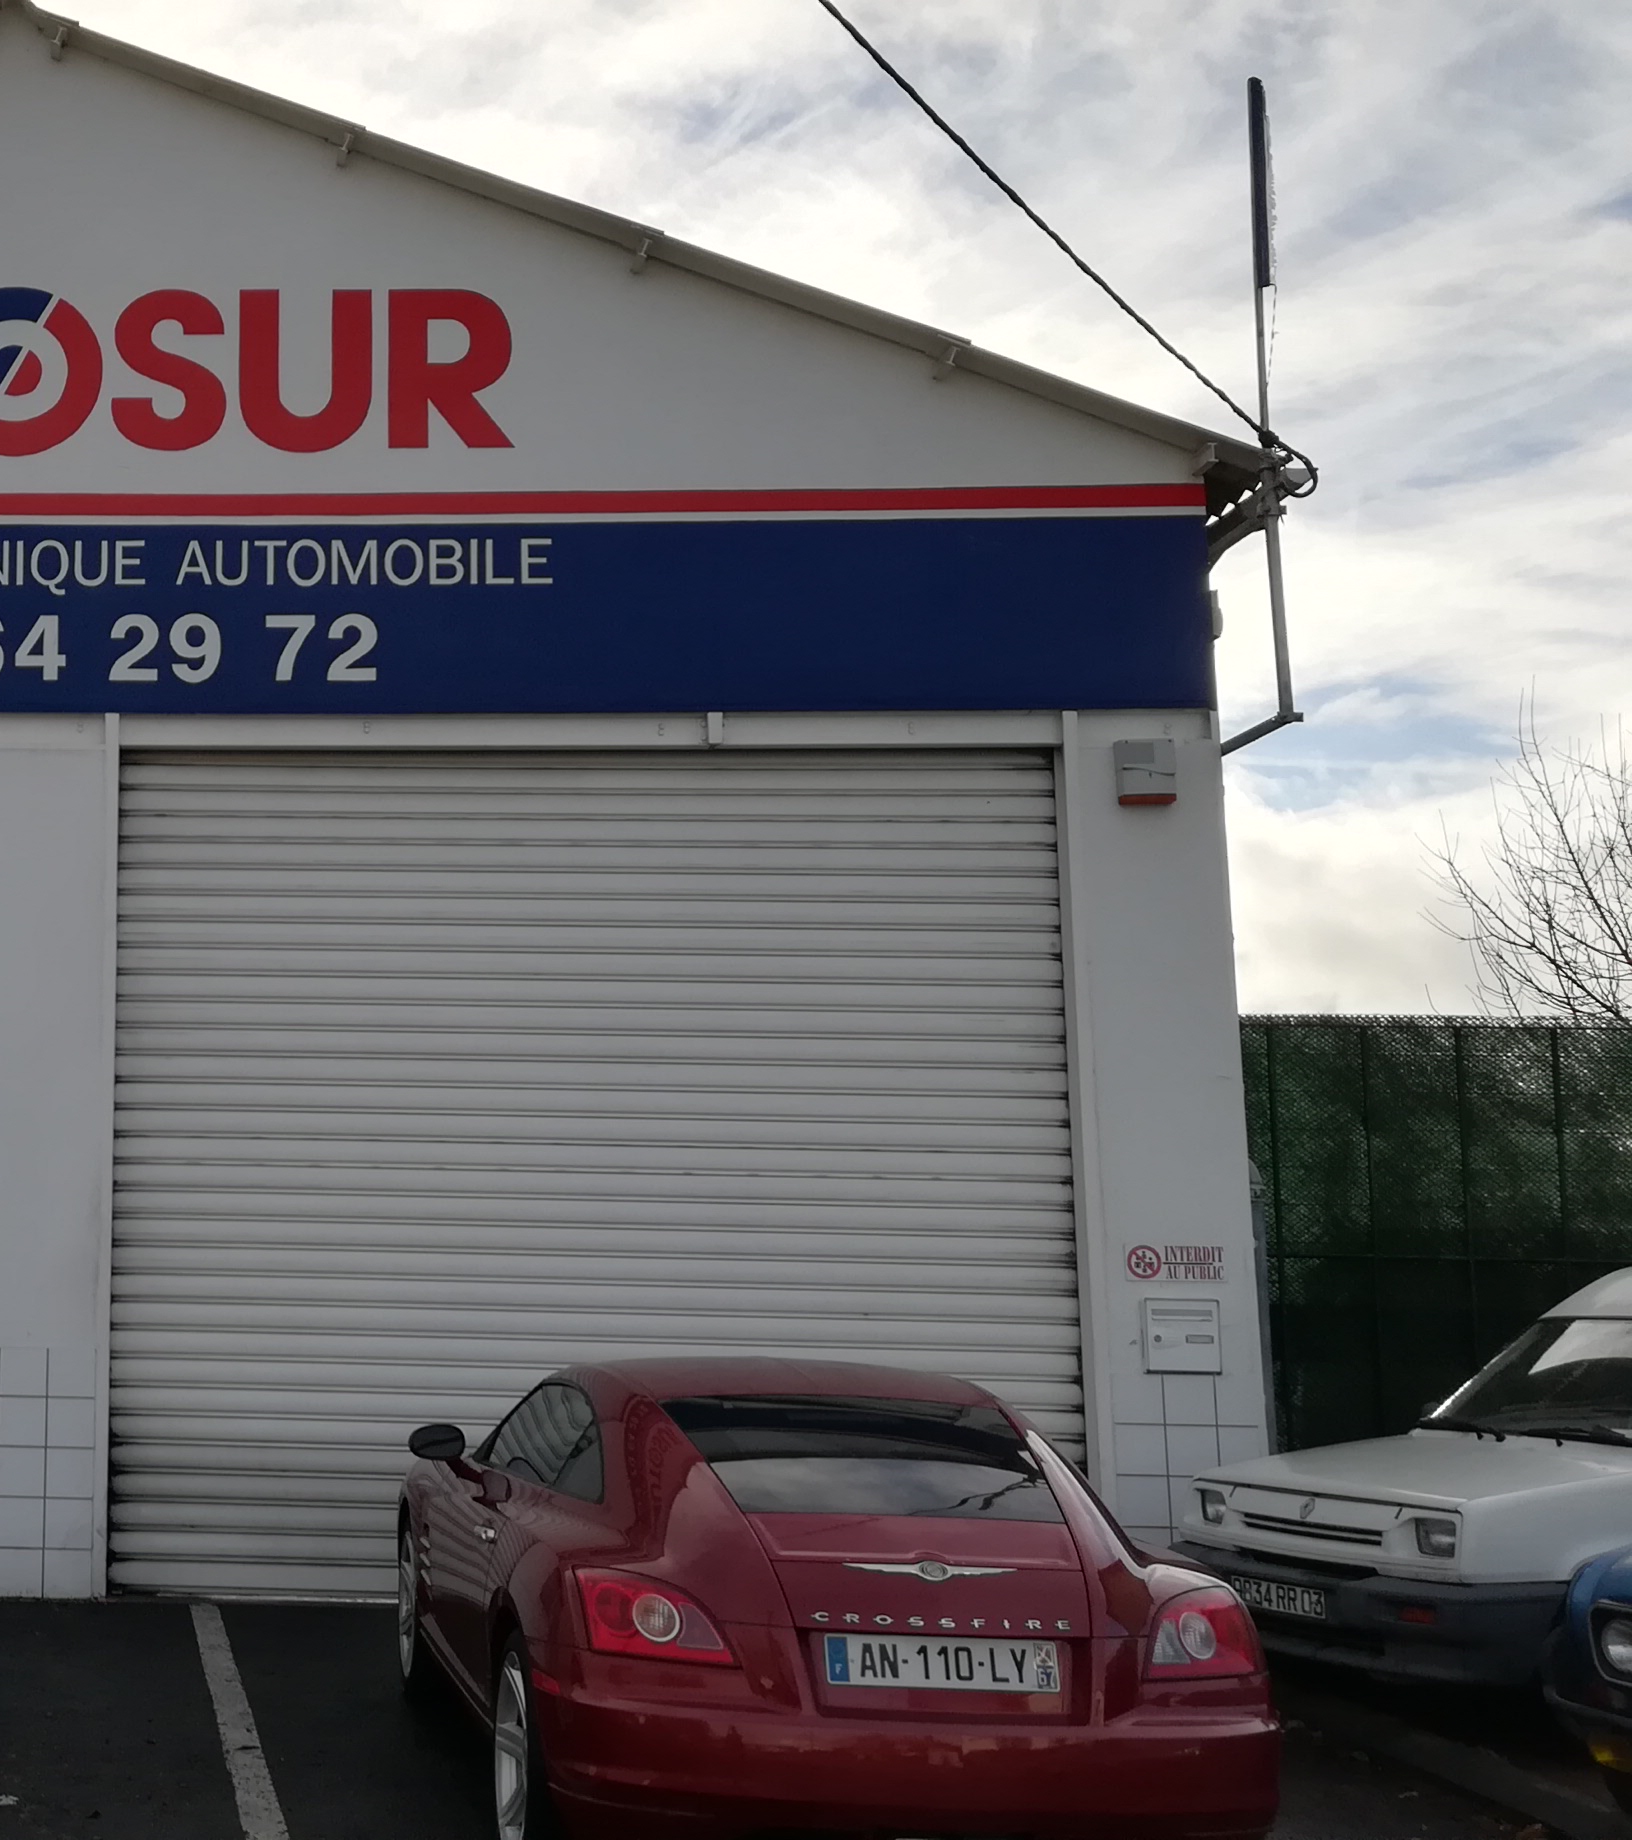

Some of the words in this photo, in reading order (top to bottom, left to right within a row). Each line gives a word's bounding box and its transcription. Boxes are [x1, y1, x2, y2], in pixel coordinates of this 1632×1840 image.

[175, 538, 554, 587] AUTOMOBILE
[108, 613, 222, 684] 29
[265, 613, 378, 682] 72
[1163, 1245, 1225, 1263] INTERDIT
[1165, 1265, 1181, 1280] AU
[1183, 1265, 1225, 1281] PUBLIC
[1276, 1585, 1298, 1612] RR
[1301, 1588, 1324, 1617] 03
[810, 1610, 1072, 1631] CROSSFIRE
[835, 1662, 843, 1676] F
[859, 1642, 1028, 1685] AN-110-LY
